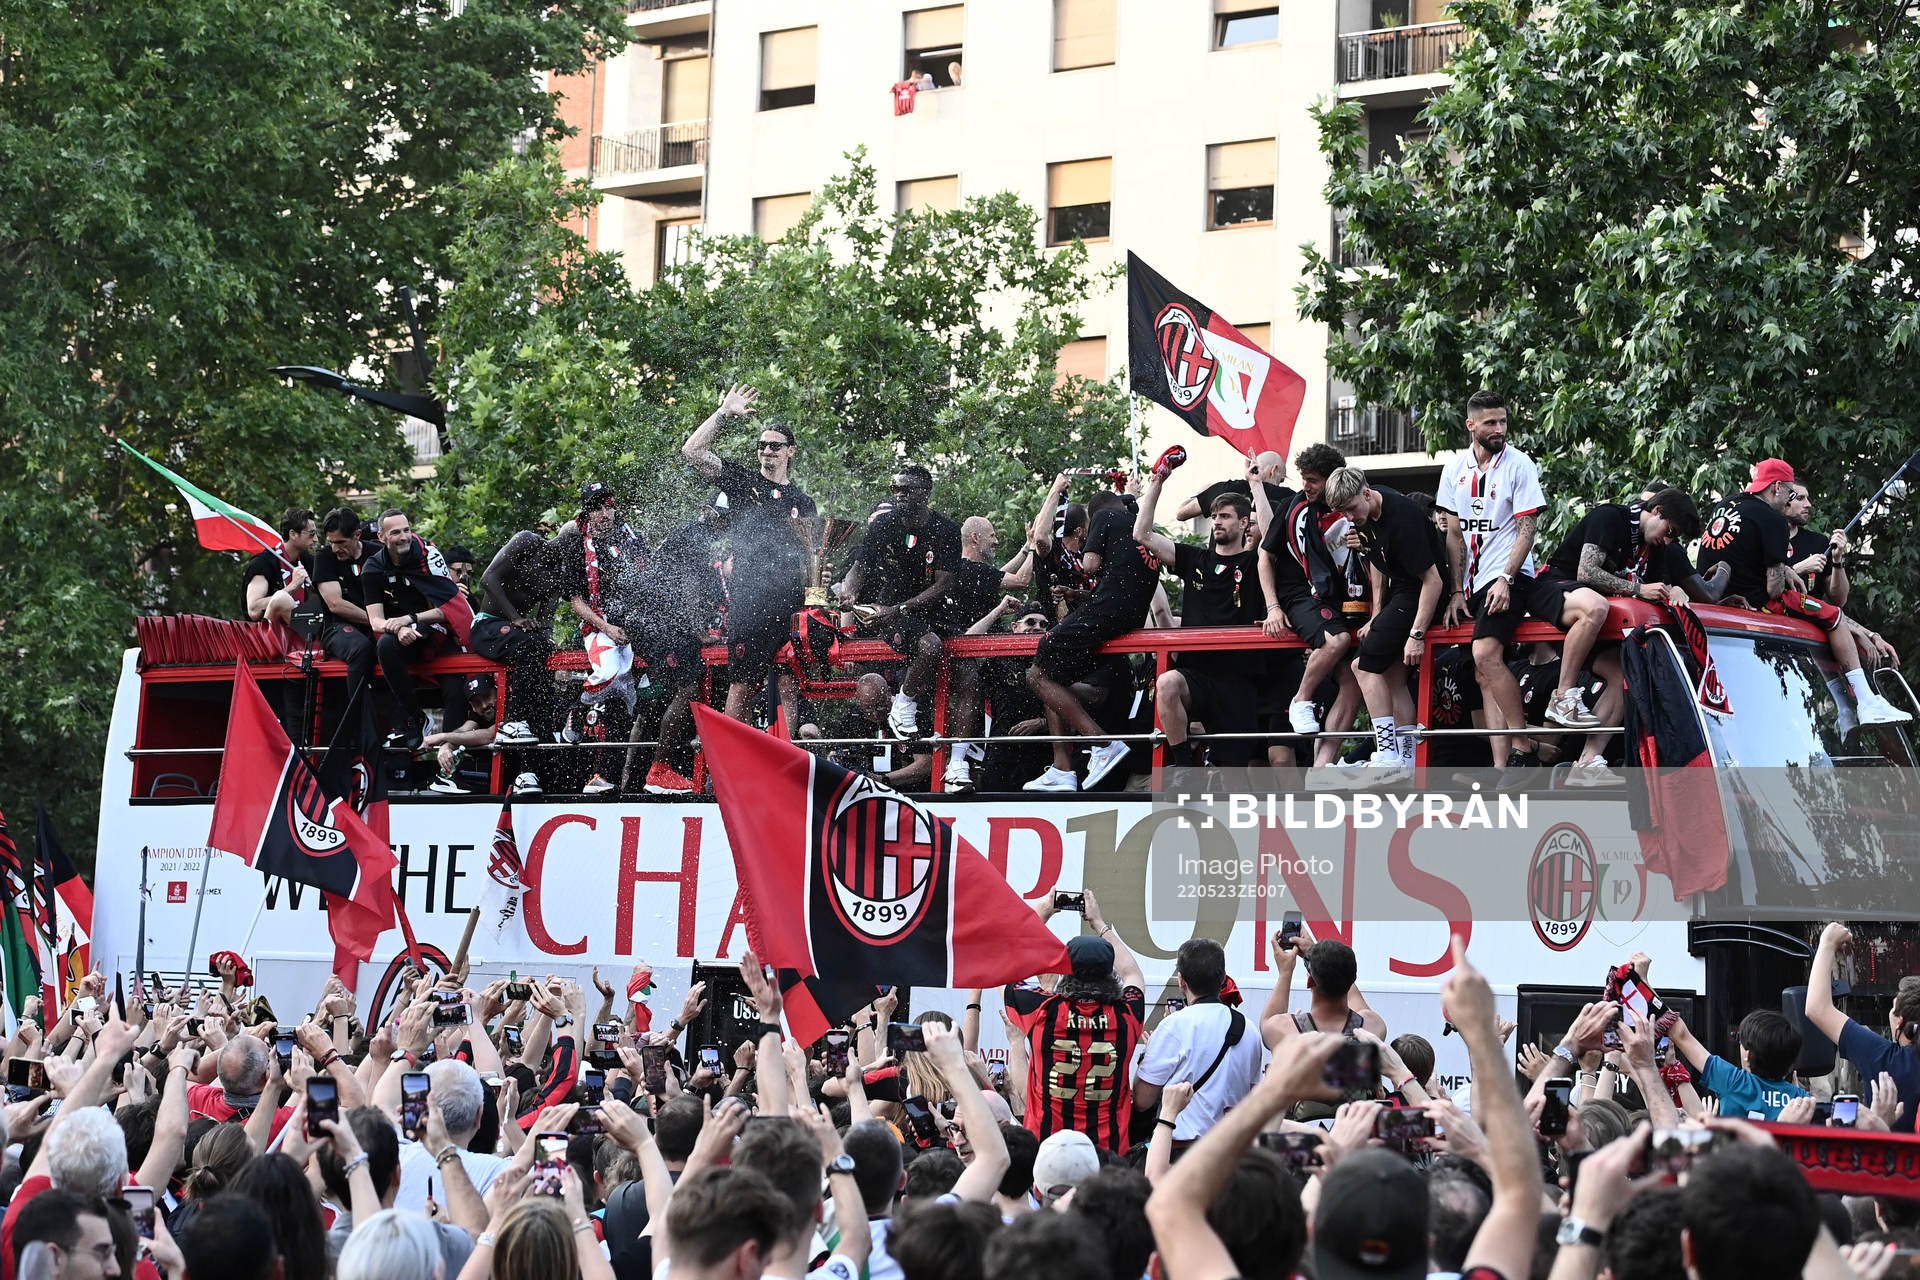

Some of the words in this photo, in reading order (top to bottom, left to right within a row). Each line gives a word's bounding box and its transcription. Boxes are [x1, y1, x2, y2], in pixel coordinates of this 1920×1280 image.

[1459, 518, 1500, 532] OPEL
[300, 821, 338, 844] 1899
[1545, 833, 1583, 856] ACM
[160, 862, 177, 871] 2021
[183, 862, 201, 871] 2022
[390, 844, 475, 914] HE
[1612, 879, 1632, 904] 19
[852, 900, 907, 923] 1899
[1545, 921, 1578, 936] 1899
[1067, 1010, 1109, 1029] KAKA
[1048, 1039, 1118, 1100] 22
